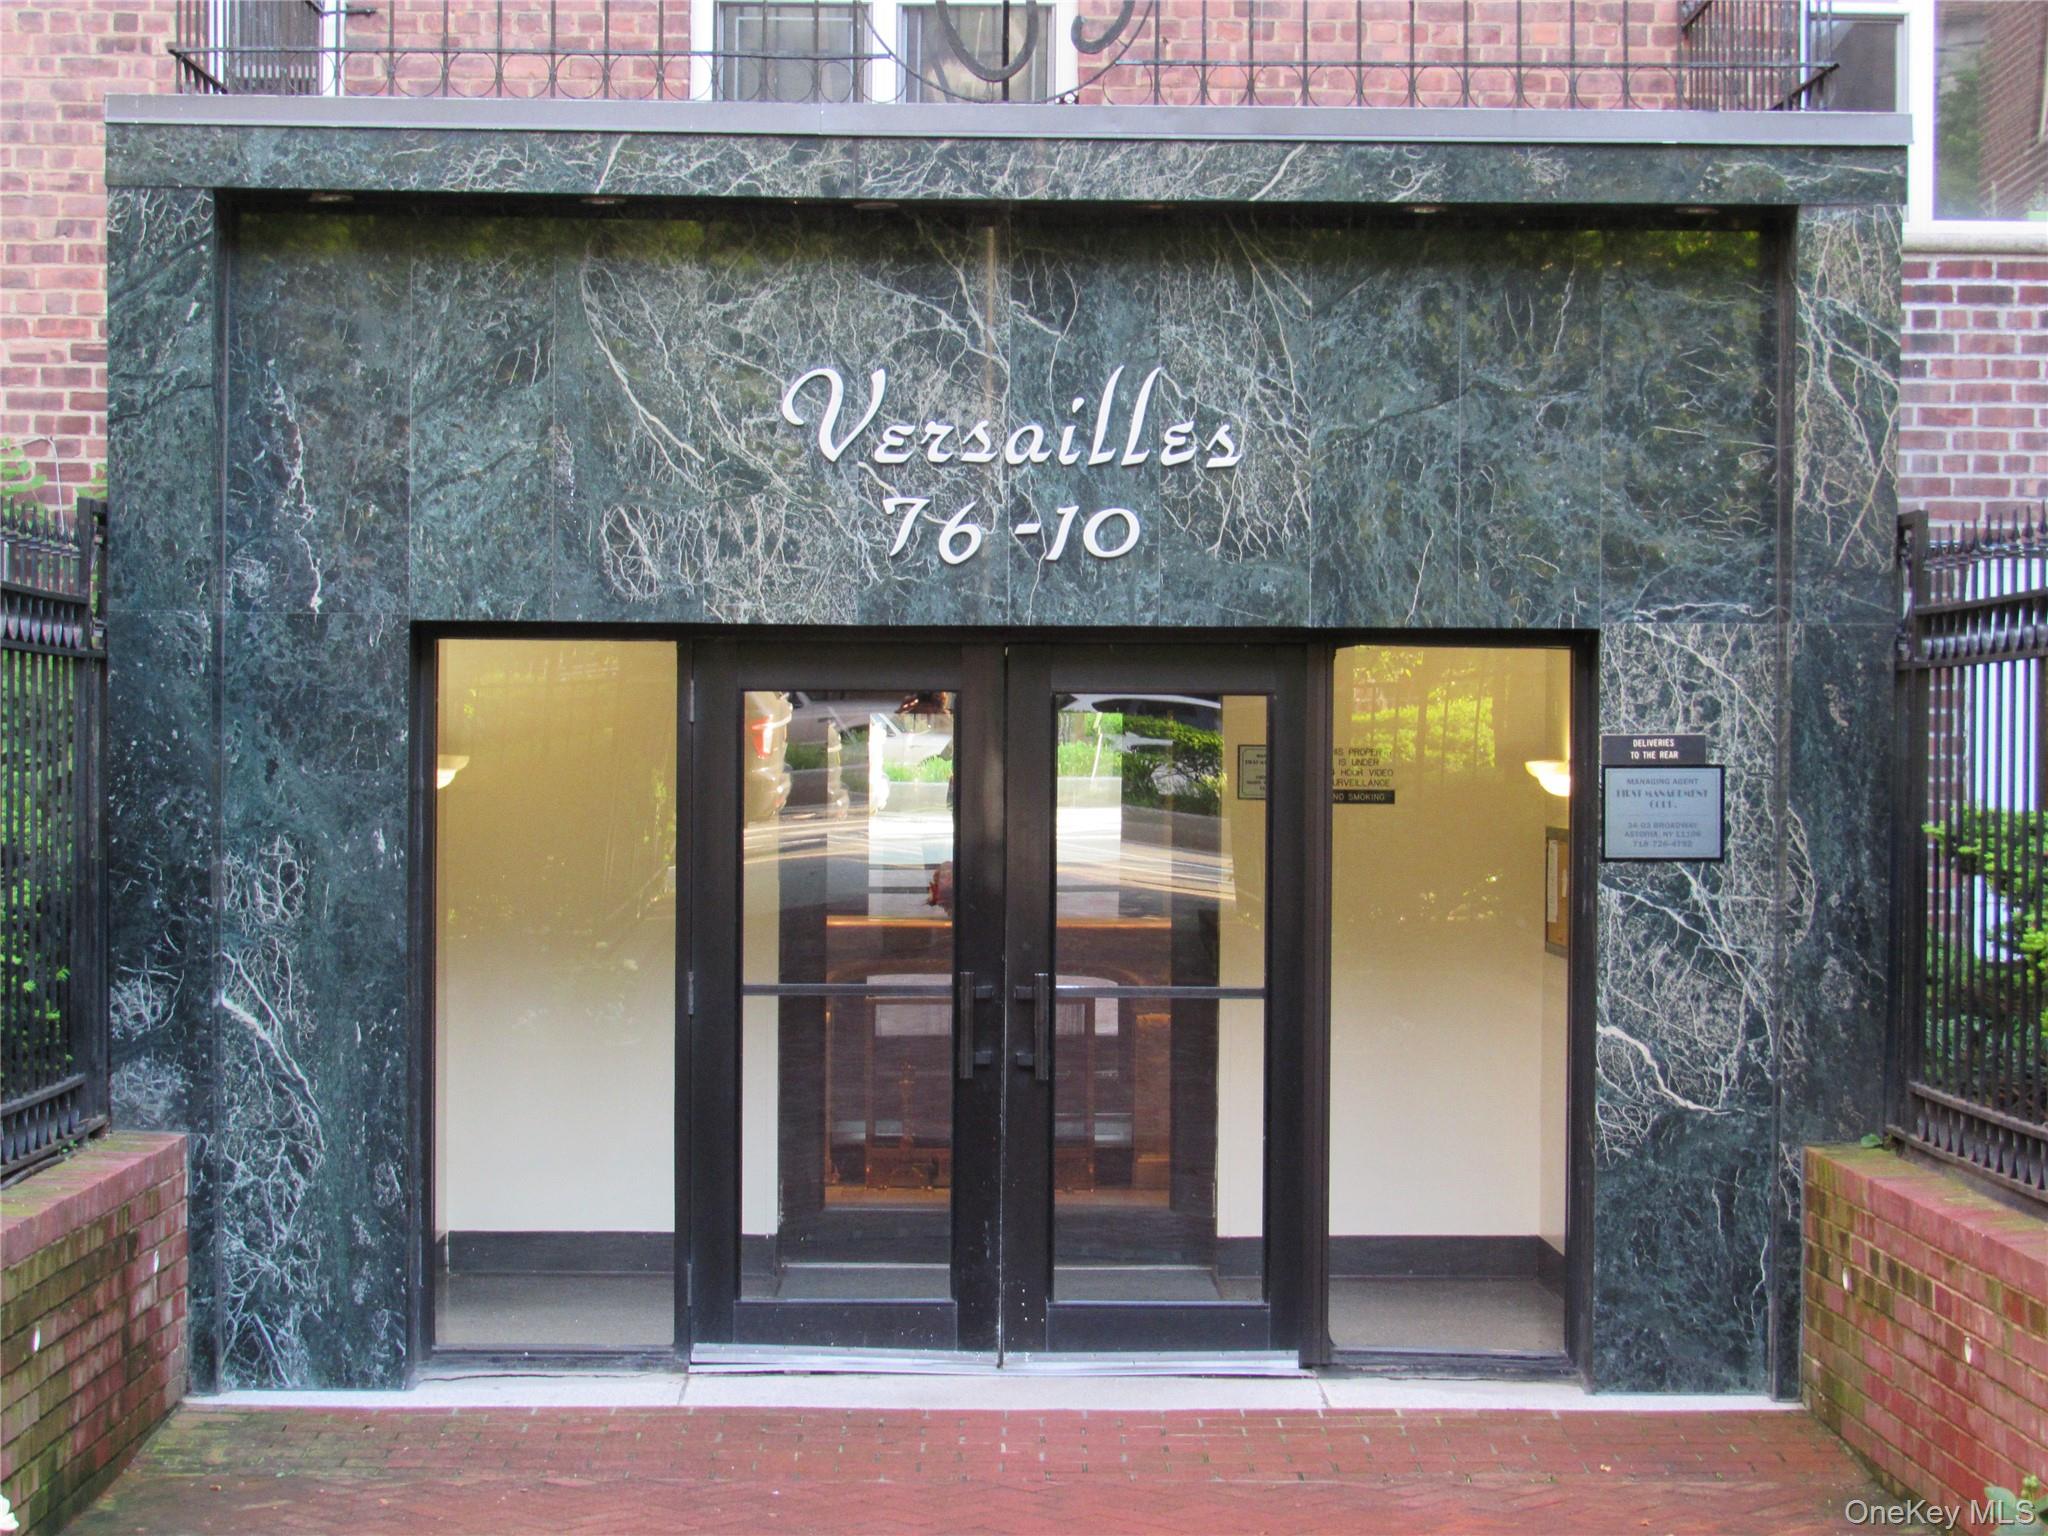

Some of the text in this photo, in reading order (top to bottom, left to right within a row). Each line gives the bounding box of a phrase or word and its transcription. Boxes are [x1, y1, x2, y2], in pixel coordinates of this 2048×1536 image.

[782, 365, 1242, 468] Versailles
[883, 497, 1141, 565] 76-10
[1632, 738, 1675, 748] DELIVERIES
[1630, 750, 1679, 760] TO THE REAR
[1351, 758, 1380, 766] UNDER
[1340, 768, 1364, 777] HOUR
[1368, 768, 1394, 777] VIDEO
[1626, 777, 1699, 786] MANAGING AGENT
[1333, 792, 1385, 801] NO SMOKING
